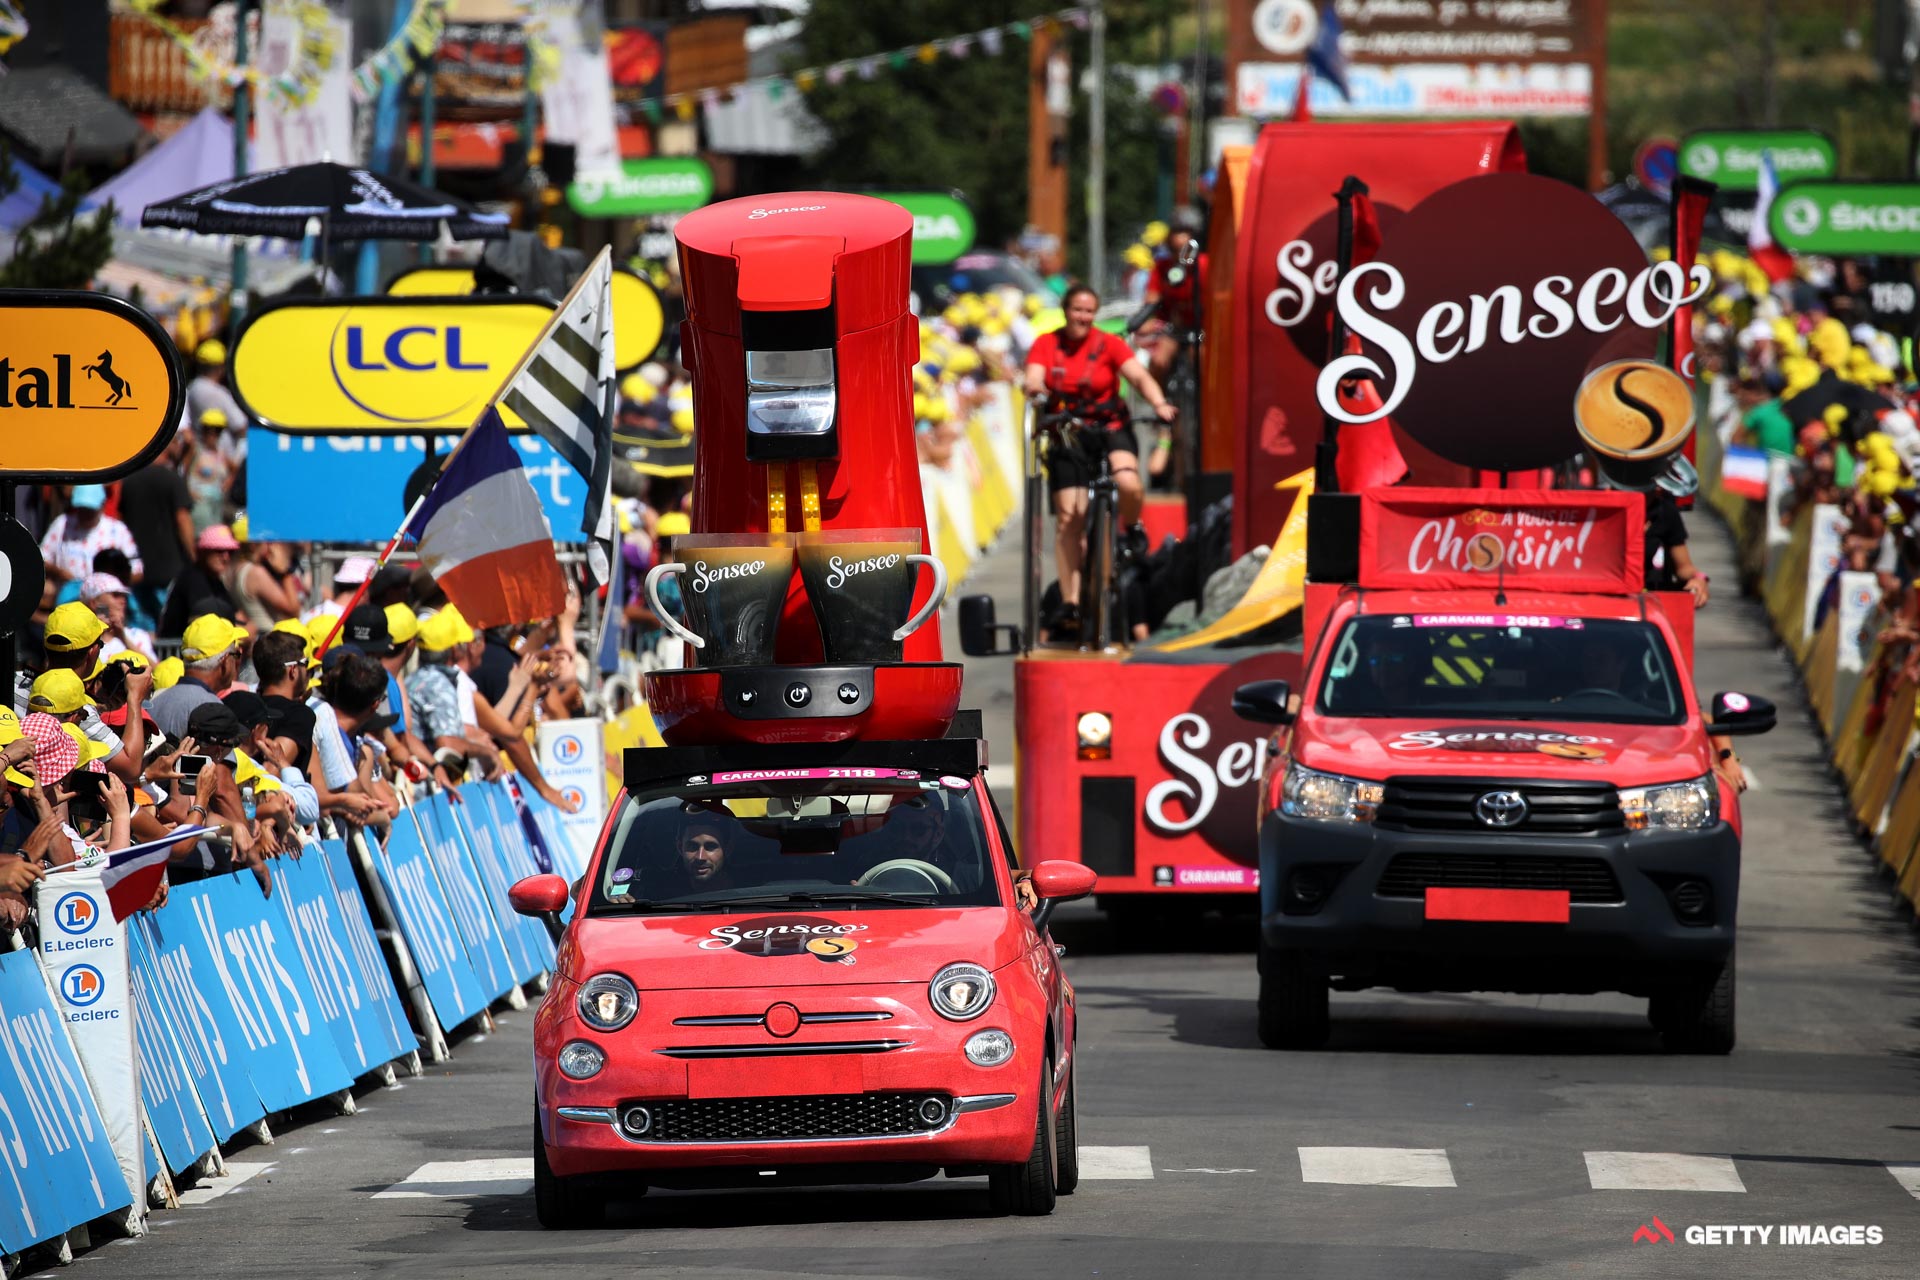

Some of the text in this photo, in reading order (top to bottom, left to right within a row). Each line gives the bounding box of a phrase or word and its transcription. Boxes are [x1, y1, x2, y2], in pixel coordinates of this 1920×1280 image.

[748, 206, 826, 220] Senseo
[346, 326, 489, 372] LCL
[1316, 260, 1710, 424] Senseo
[692, 560, 765, 593] Senseo
[826, 554, 899, 589] Senseo
[1421, 616, 1550, 627] CARAVANE 2082
[1388, 730, 1614, 751] Senseo
[721, 769, 876, 781] CARAVANE 2118
[44, 937, 115, 953] E.Leclerc
[698, 924, 869, 950] Senseo
[274, 868, 367, 1068] Krys
[191, 893, 311, 1096] Krys
